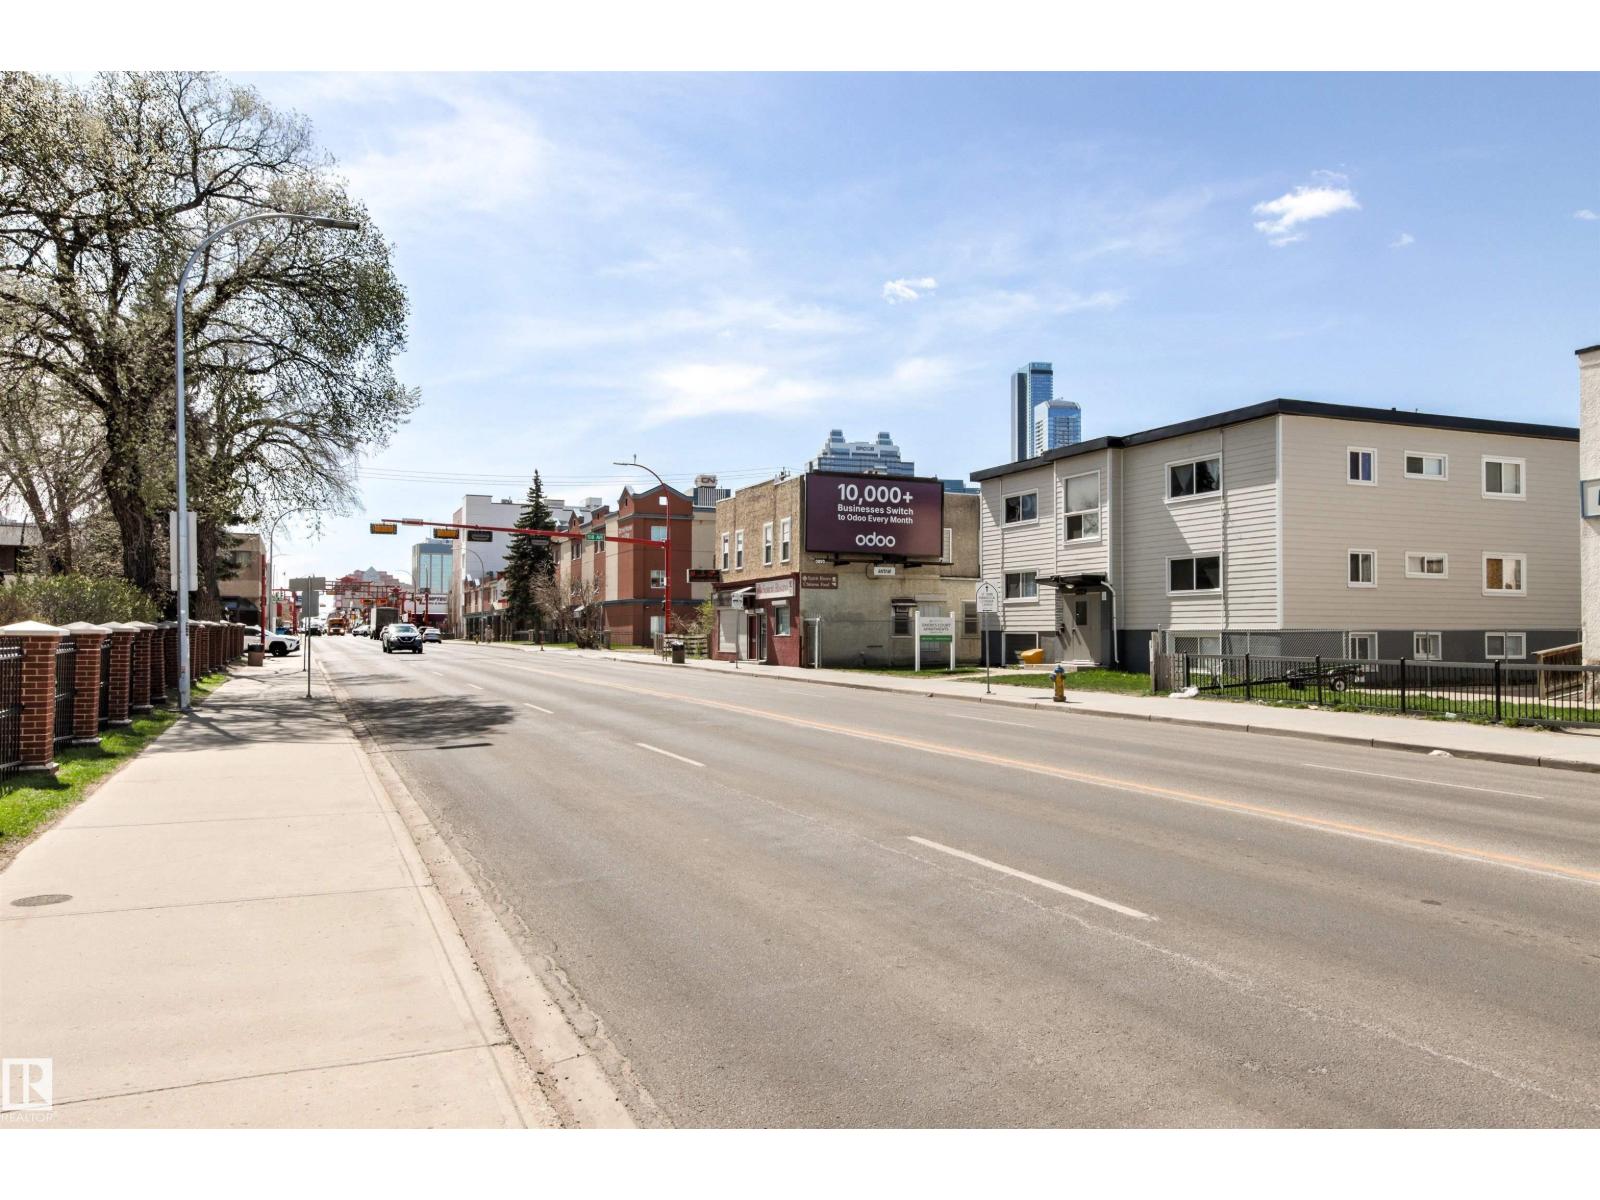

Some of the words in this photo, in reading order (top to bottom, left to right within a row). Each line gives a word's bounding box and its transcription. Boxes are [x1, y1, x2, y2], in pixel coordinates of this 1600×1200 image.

[837, 483, 914, 506] 10,000+
[837, 503, 885, 514] Businesses
[886, 506, 914, 516] Switch
[837, 513, 846, 521] to
[847, 513, 867, 522] Odoo
[867, 514, 889, 525] Every
[889, 515, 914, 524] Month
[855, 531, 896, 548] odoo
